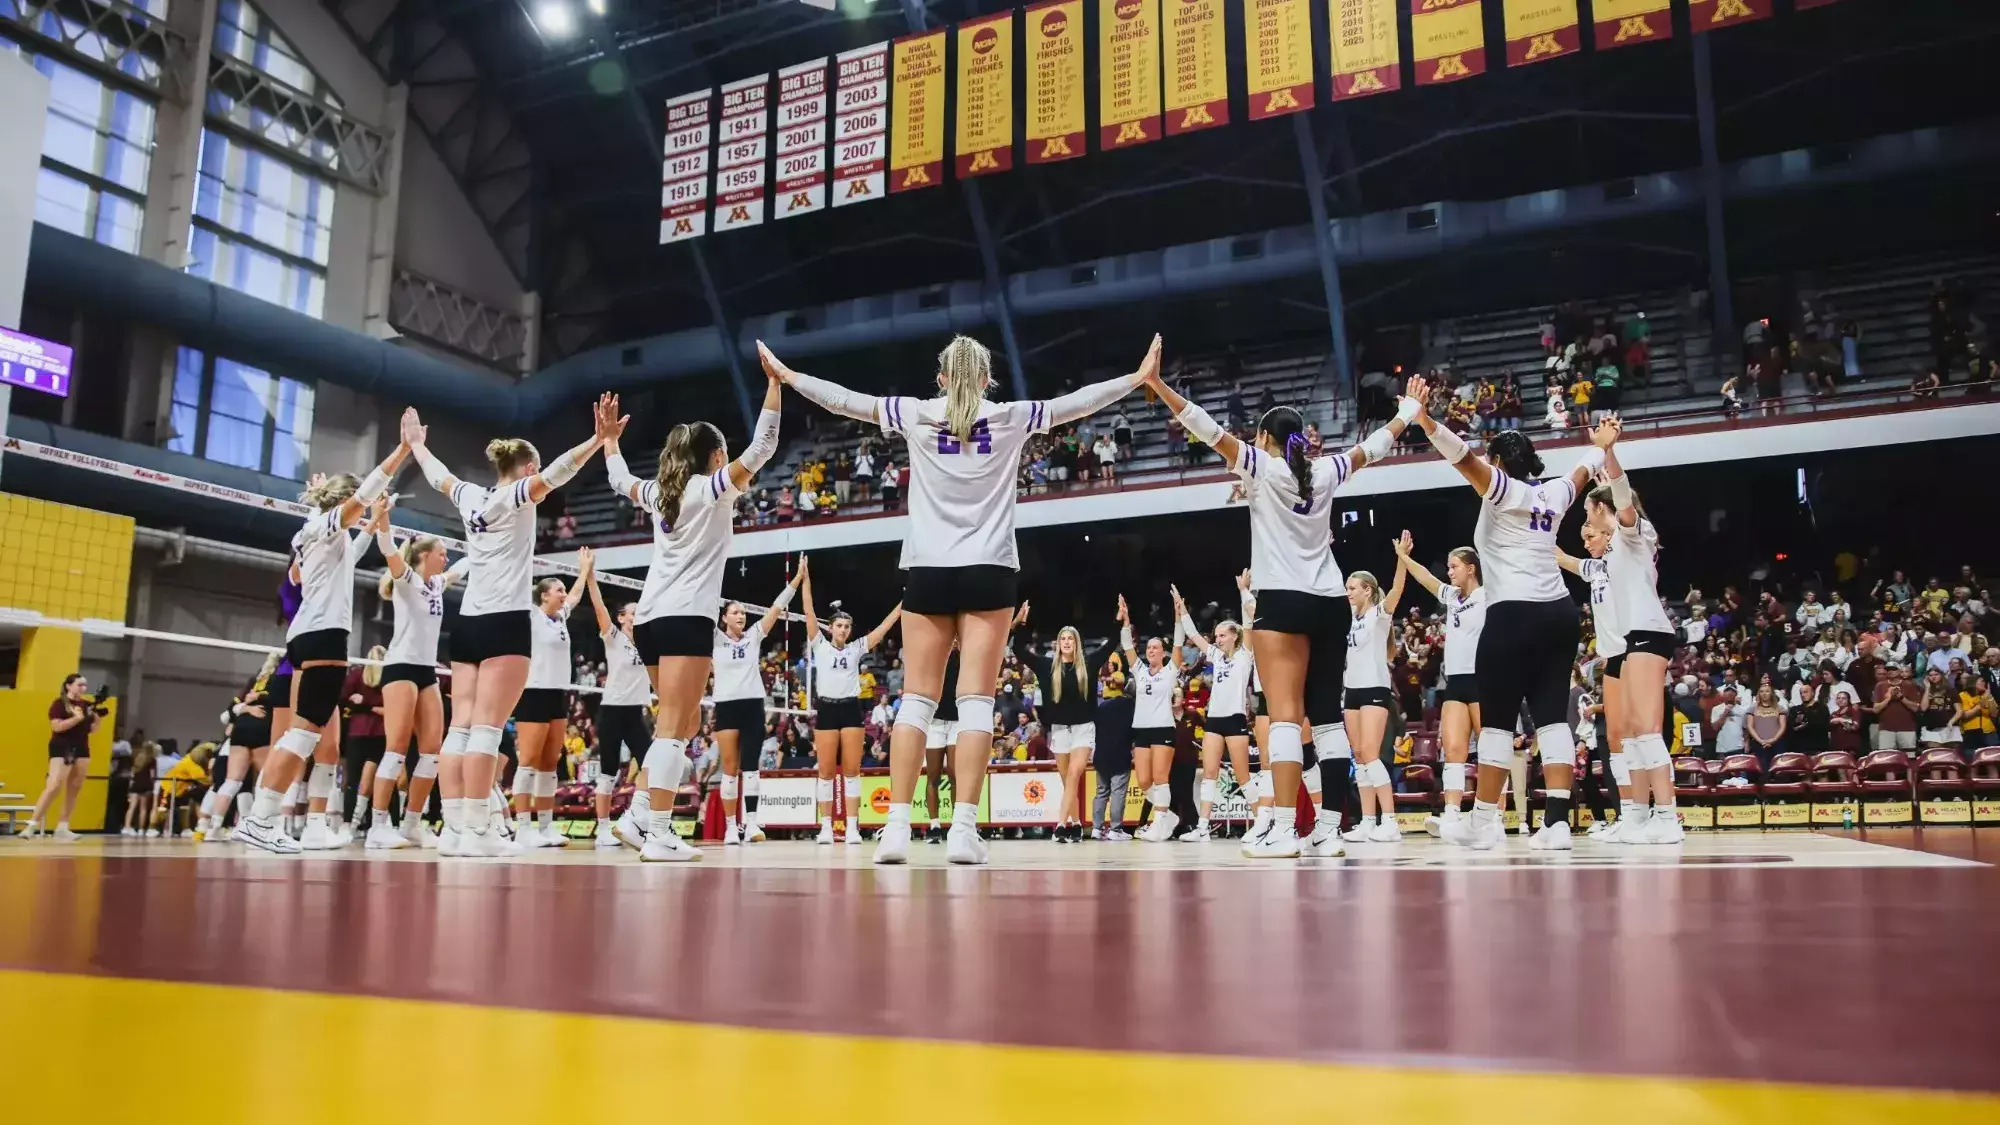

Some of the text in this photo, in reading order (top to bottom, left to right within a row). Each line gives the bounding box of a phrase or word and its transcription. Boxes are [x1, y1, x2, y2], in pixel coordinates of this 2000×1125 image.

[1174, 10, 1214, 27] FINISHES
[1178, 6, 1195, 16] TOP
[1115, 19, 1145, 33] TOP 10
[1041, 37, 1069, 50] TOP 10
[1110, 27, 1149, 43] FINISHES
[908, 41, 931, 54] NWCA
[1036, 46, 1074, 60] FINISHES
[840, 54, 884, 76] BIG TEN
[901, 50, 938, 64] NATIONAL
[907, 59, 931, 71] DUALS
[972, 56, 987, 67] TOP
[838, 68, 885, 86] CHAMPIONS
[896, 65, 942, 83] CHAMPIONS
[967, 62, 1003, 76] FINISHES
[781, 70, 824, 92] BIG TEN
[724, 86, 765, 107] BIG TEN
[781, 84, 824, 102] CHAMPIONS
[844, 86, 877, 106] 2003
[669, 101, 708, 121] BIG TEN
[723, 99, 765, 116] CHAMPIONS
[786, 101, 818, 120] 1999
[668, 113, 708, 130] CHAMPIONS
[728, 117, 758, 134] 1941
[843, 113, 877, 133] 2006
[673, 131, 702, 148] 1910
[785, 128, 816, 147] 2001
[727, 143, 758, 160] 1957
[843, 141, 876, 161] 2007
[672, 156, 701, 174] 1912
[784, 155, 817, 174] 2002
[725, 170, 757, 187] 1959
[671, 183, 699, 200] 1913
[832, 657, 848, 669] 14
[760, 794, 812, 809] Huntington
